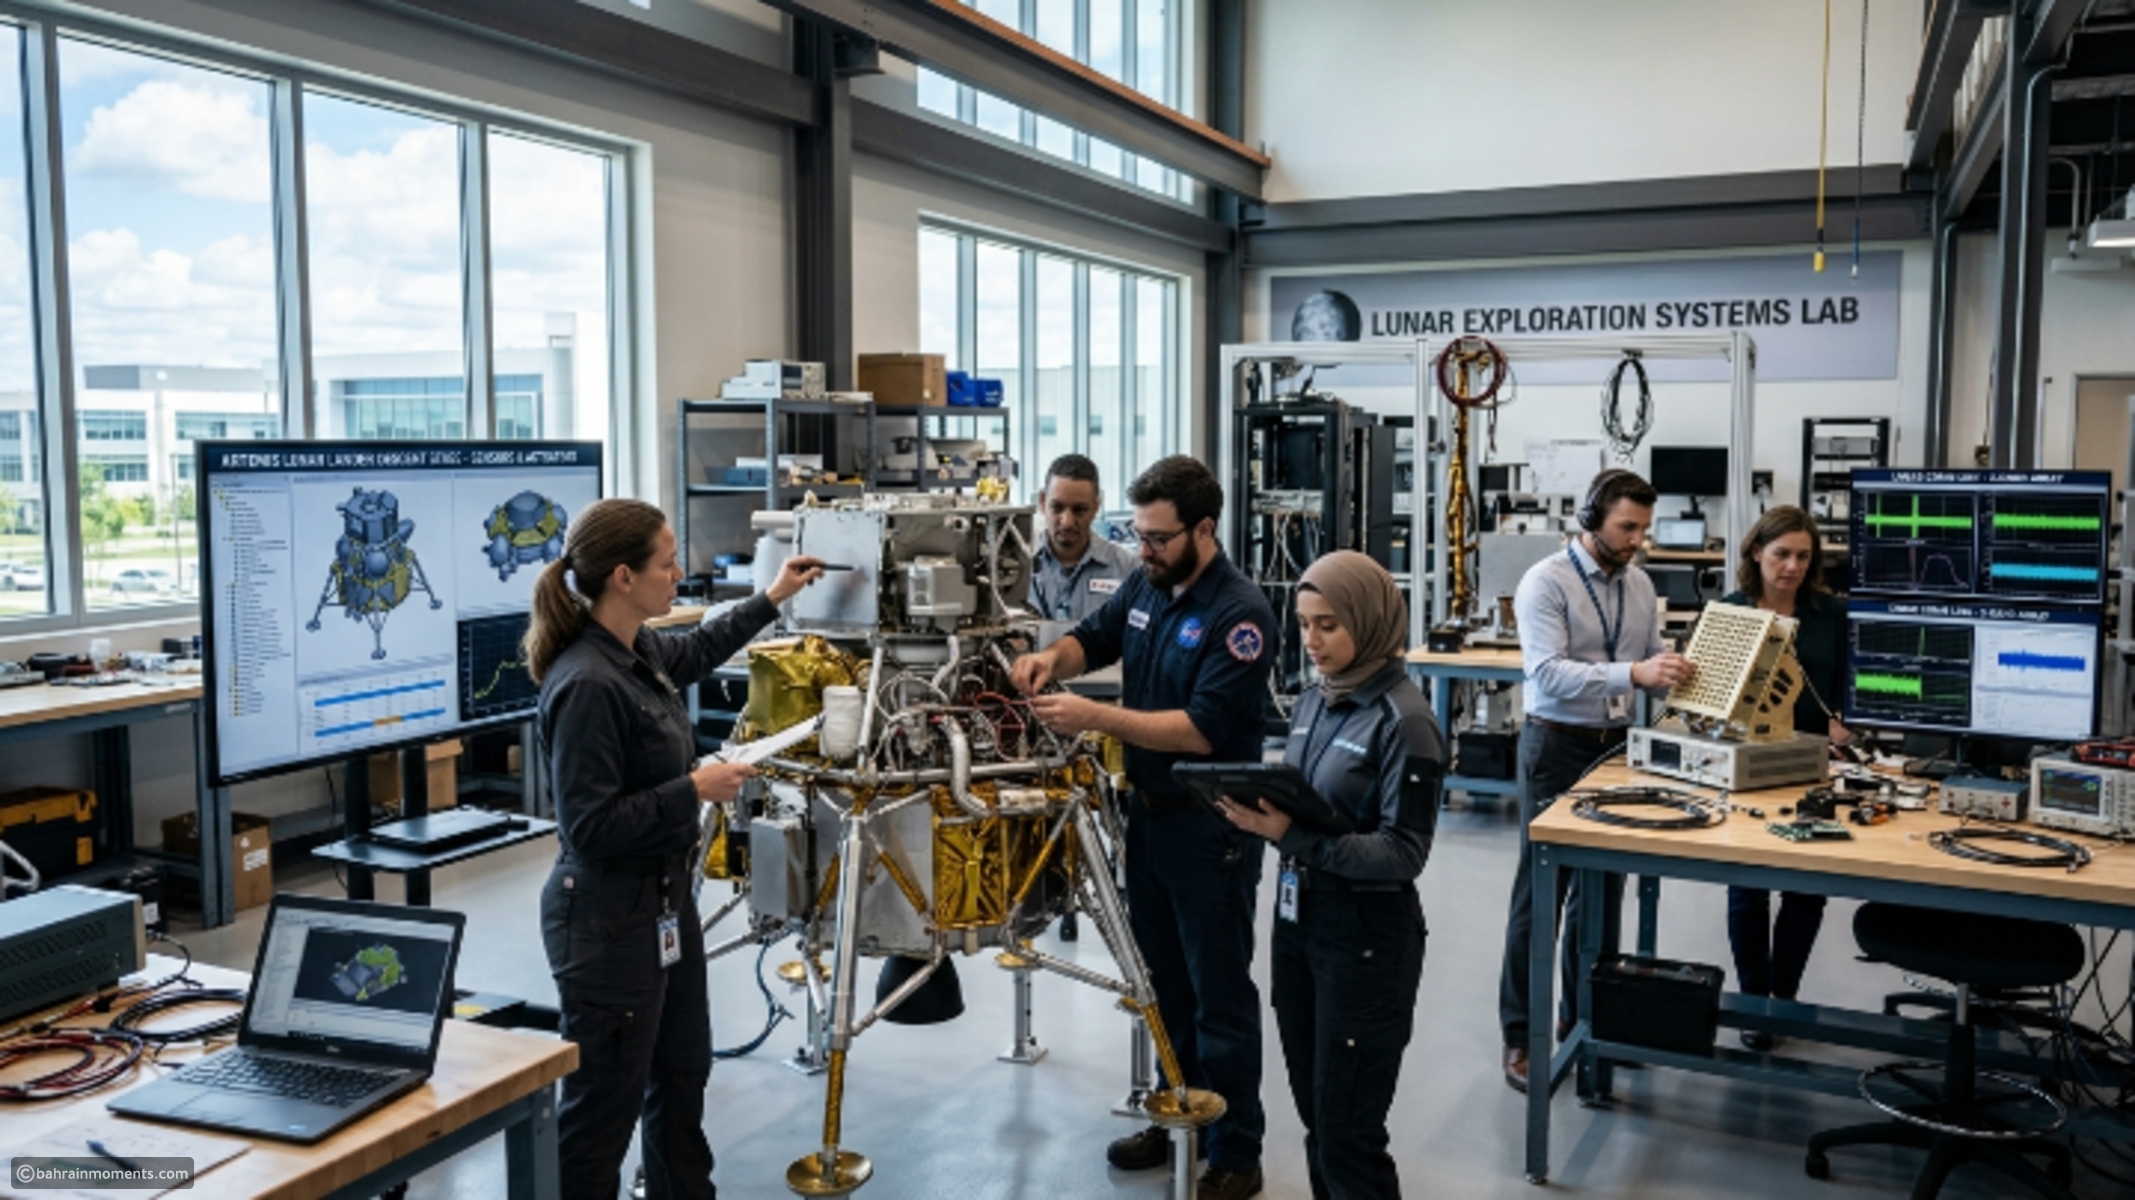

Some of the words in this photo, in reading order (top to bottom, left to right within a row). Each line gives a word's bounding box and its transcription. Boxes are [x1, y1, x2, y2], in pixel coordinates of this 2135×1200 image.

[1371, 310, 1454, 336] LUNAR
[1463, 304, 1646, 334] EXPLORATION
[1656, 299, 1791, 329] SYSTEMS
[1801, 297, 1860, 325] LAB
